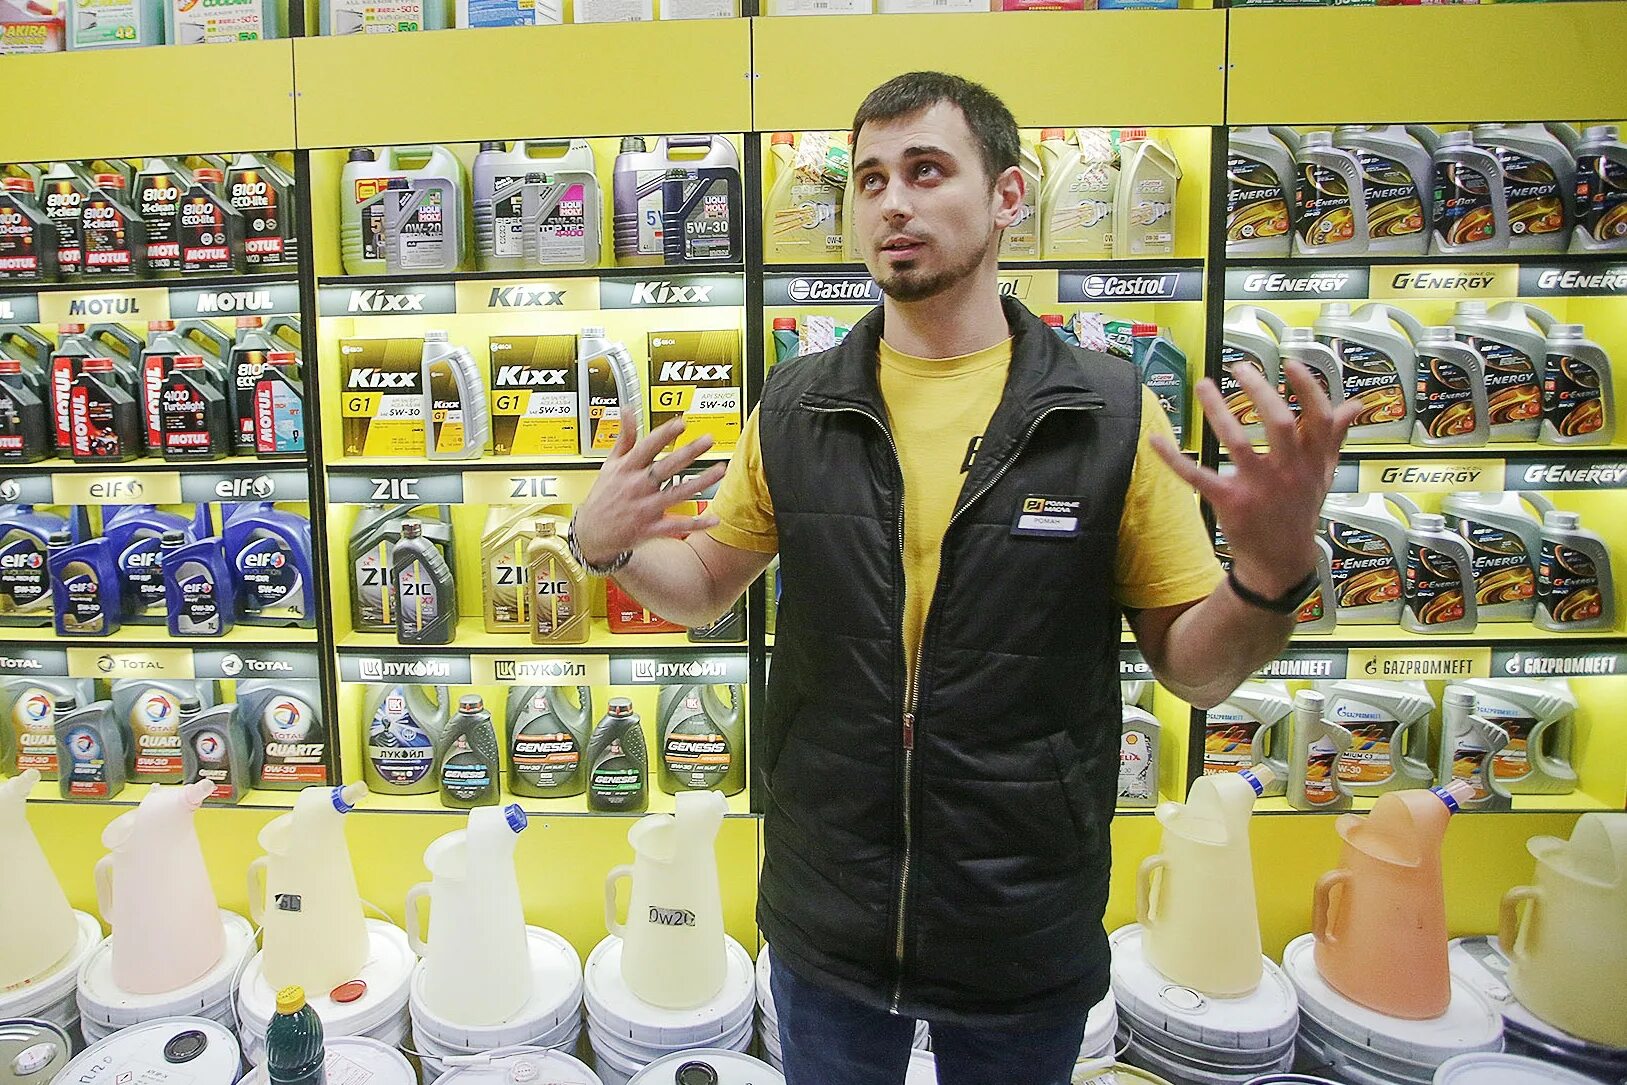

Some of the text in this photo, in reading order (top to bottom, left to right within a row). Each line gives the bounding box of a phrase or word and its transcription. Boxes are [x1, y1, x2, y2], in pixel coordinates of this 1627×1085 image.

[6, 25, 48, 37] AKIRA
[143, 187, 178, 202] 8100
[232, 182, 267, 197] 8100
[46, 192, 80, 207] 8100
[84, 207, 115, 219] 8100
[183, 203, 213, 215] 8100
[686, 221, 729, 234] 5W-30
[87, 252, 128, 264] MOTUL
[187, 249, 226, 262] MOTUL
[631, 281, 714, 304] Kixx
[809, 279, 872, 300] Castrol
[1103, 276, 1166, 296] Castrol
[196, 291, 274, 313] MOTUL
[347, 289, 425, 312] Kixx
[487, 286, 567, 307] Kixx
[69, 298, 140, 316] MOTUL
[348, 367, 418, 388] Kixx
[496, 365, 569, 386] Kixx
[658, 360, 733, 382] Kixx
[54, 367, 71, 432] MOTUL
[164, 390, 190, 402] 4100
[496, 395, 519, 410] G1
[590, 396, 618, 405] Kixx
[659, 391, 684, 406] G1
[349, 398, 371, 412] G1
[433, 400, 460, 409] Kixx
[539, 406, 571, 414] 5W-30
[699, 400, 736, 409] 5W-40
[257, 388, 273, 444] MOTUL
[389, 408, 421, 417] 5W-30
[434, 411, 446, 420] G1
[73, 394, 90, 452] MOTUL
[168, 433, 208, 445] MOTUL
[89, 483, 123, 498] elf
[215, 478, 254, 498] elf
[370, 478, 420, 500] ZIC
[510, 477, 559, 498] ZIC
[1, 552, 28, 568] elf
[128, 552, 156, 567] elf
[245, 553, 271, 567] elf
[69, 582, 89, 593] elf
[183, 582, 204, 593] elf
[403, 583, 432, 596] ZIC
[538, 581, 568, 595] ZIC
[0, 656, 42, 670] TOTAL
[120, 659, 165, 670] TOTAL
[245, 659, 294, 671] TOTAL
[1383, 659, 1473, 675] GAZPROMNEFT
[1523, 655, 1617, 674] GAZPROMNEFT
[272, 731, 305, 741] TOTAL
[265, 743, 325, 757] QUARTZ
[515, 741, 573, 753] GENESIS
[668, 741, 726, 753] GENESIS
[1120, 752, 1142, 761] ELIX
[594, 775, 638, 784] GENESIS
